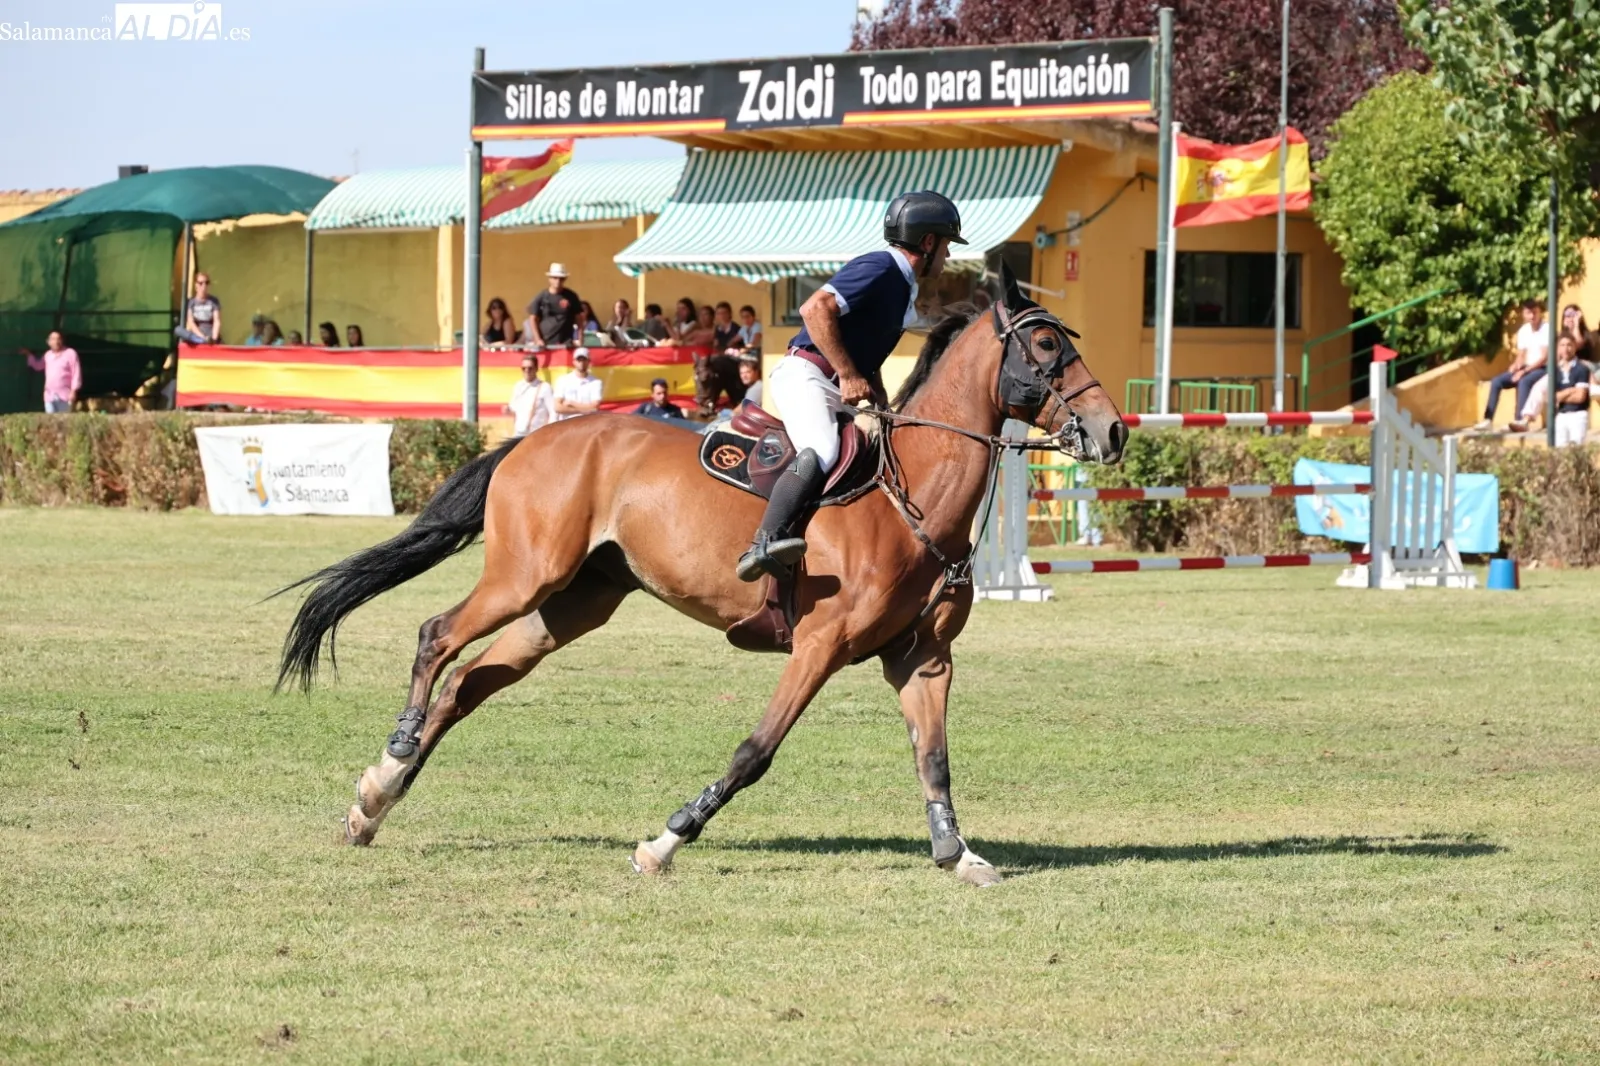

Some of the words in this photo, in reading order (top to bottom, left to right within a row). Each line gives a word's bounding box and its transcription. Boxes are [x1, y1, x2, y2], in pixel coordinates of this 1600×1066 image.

[505, 83, 571, 120] Sillas
[579, 82, 608, 117] de
[616, 80, 704, 117] Montar
[736, 62, 835, 122] Zaldi
[860, 65, 919, 105] Todo
[925, 68, 982, 110] para
[990, 53, 1130, 107] Equitación
[285, 483, 349, 502] Salamanca
